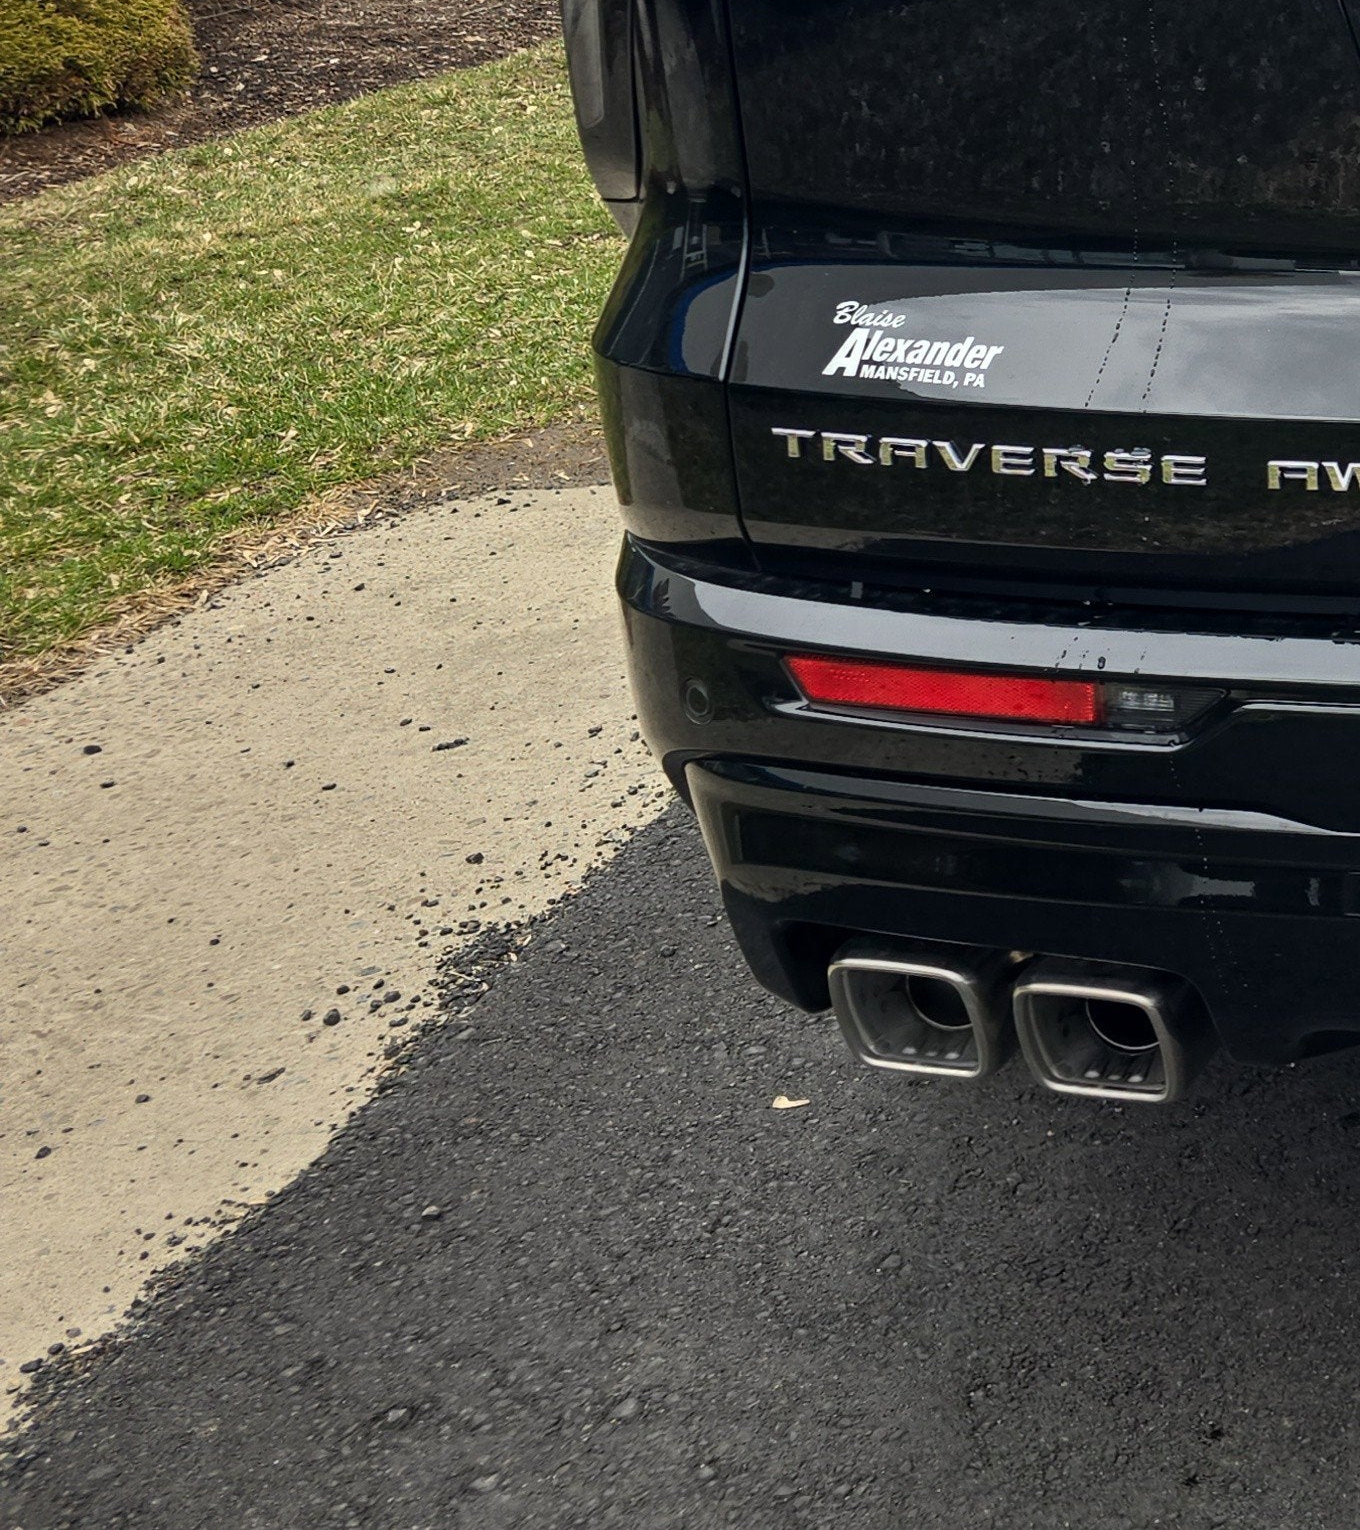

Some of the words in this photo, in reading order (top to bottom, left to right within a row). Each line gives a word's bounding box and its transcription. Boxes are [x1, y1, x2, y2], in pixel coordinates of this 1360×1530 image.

[832, 300, 907, 328] Blaise
[822, 327, 1005, 378] Alexander
[858, 364, 959, 389] MANSFIELD,
[963, 372, 986, 388] PA
[770, 426, 1207, 487] TRAVERSE
